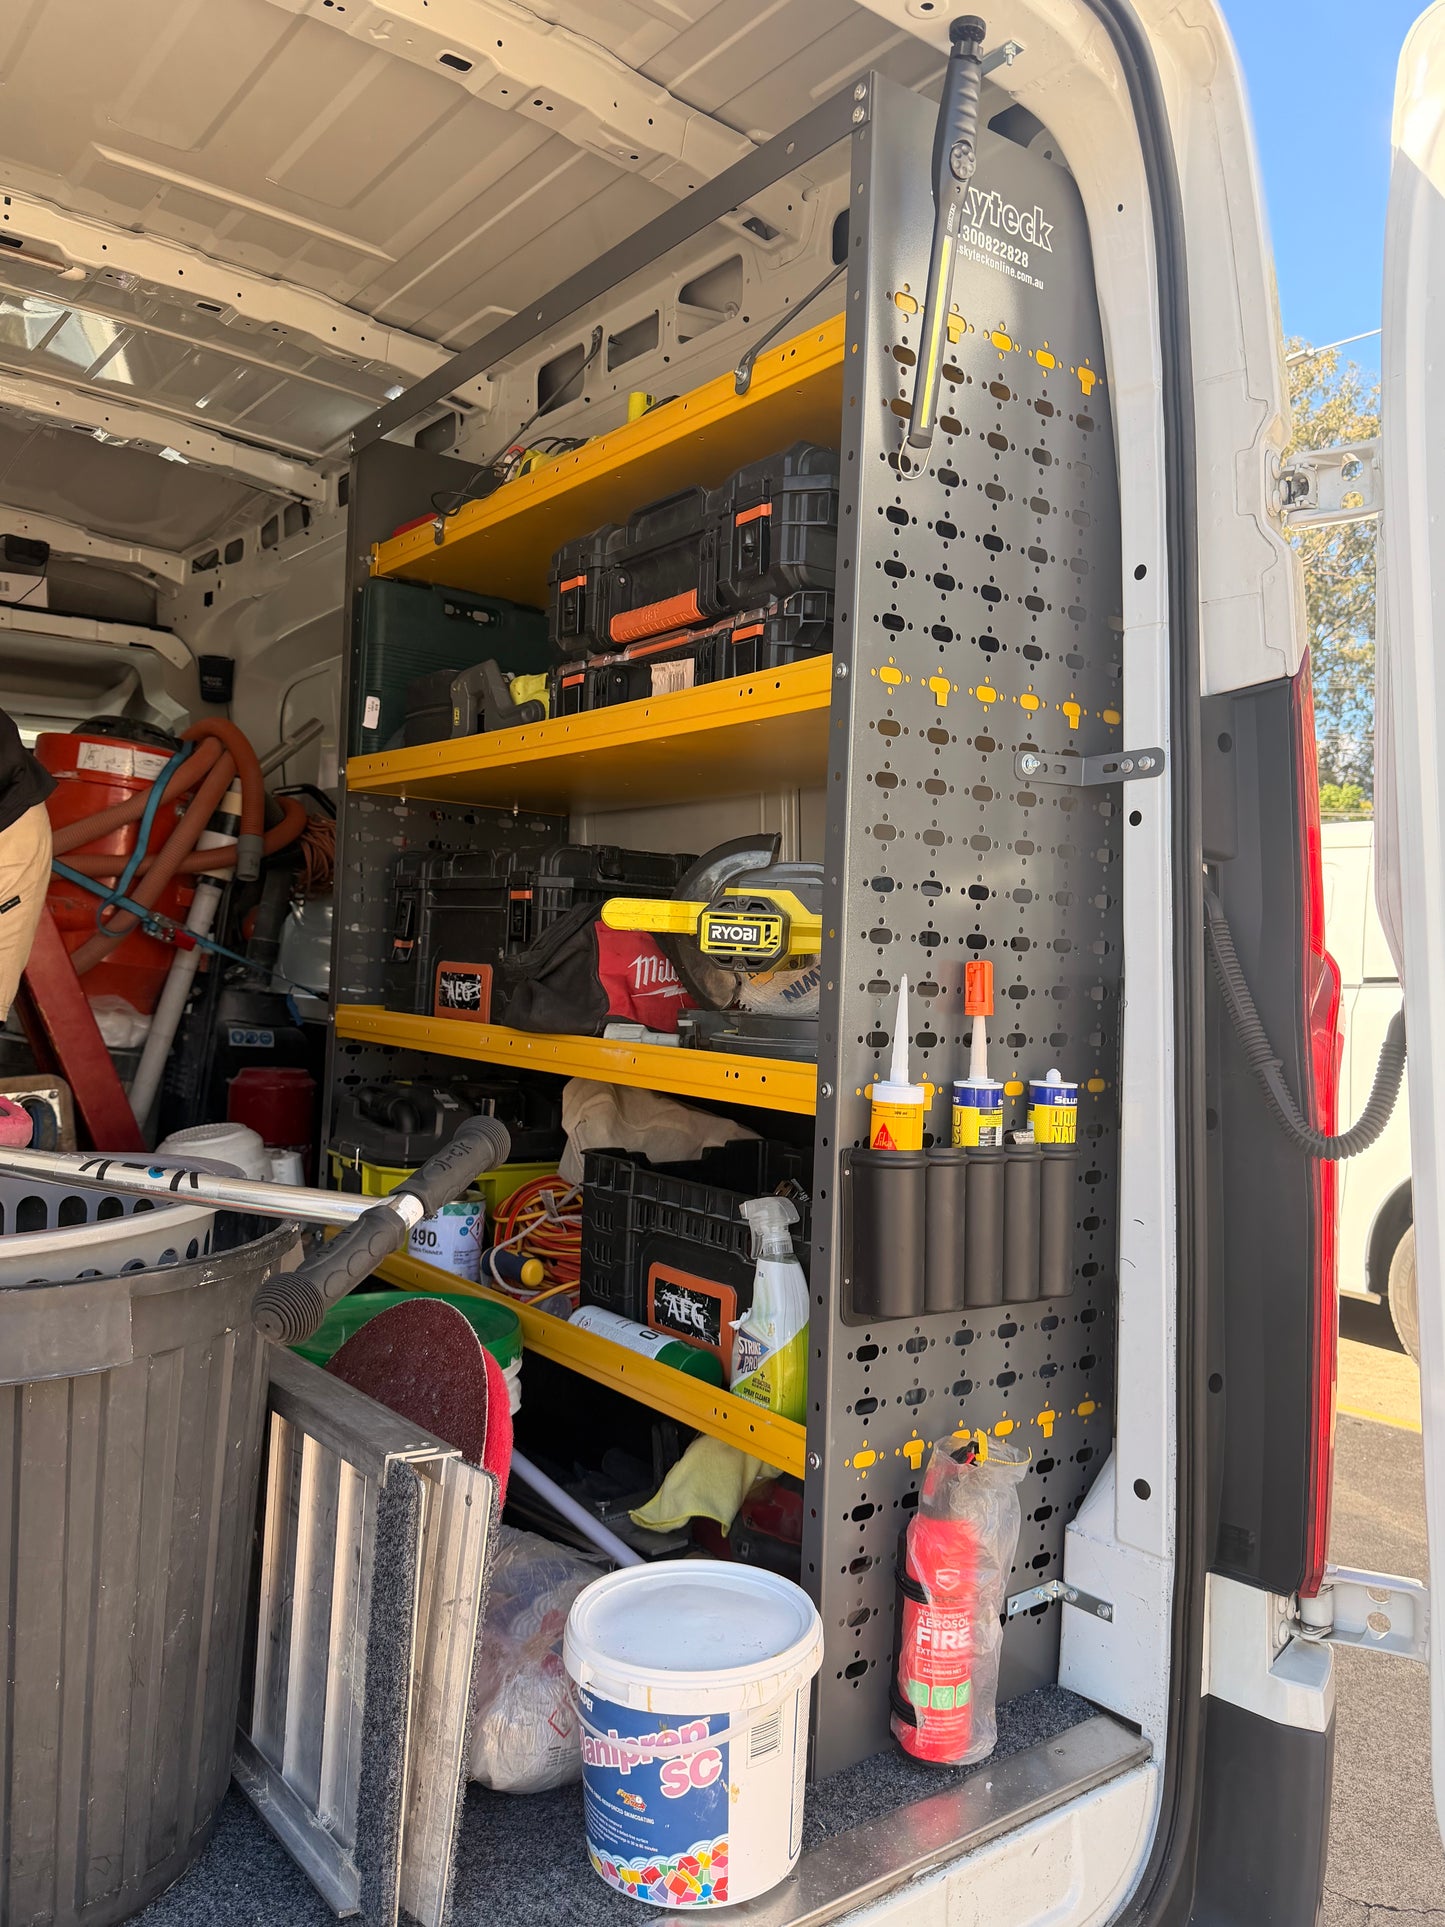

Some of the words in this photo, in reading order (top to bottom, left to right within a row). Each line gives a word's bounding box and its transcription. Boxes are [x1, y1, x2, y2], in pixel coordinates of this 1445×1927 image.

[962, 186, 1054, 253] yteck
[957, 224, 1029, 268] 300822828
[711, 925, 757, 942] RYOBI
[782, 965, 820, 1003] WIN
[874, 1131, 893, 1148] Sika
[411, 1228, 437, 1247] 490
[667, 1297, 704, 1330] AEG
[738, 1336, 762, 1356] STRIKE
[742, 1355, 759, 1374] PRO
[744, 1387, 755, 1397] SPRAY
[755, 1390, 771, 1404] CLEANER
[917, 1616, 970, 1629] AEROSOL
[916, 1625, 972, 1650] FIRE
[660, 1747, 722, 1799] SC
